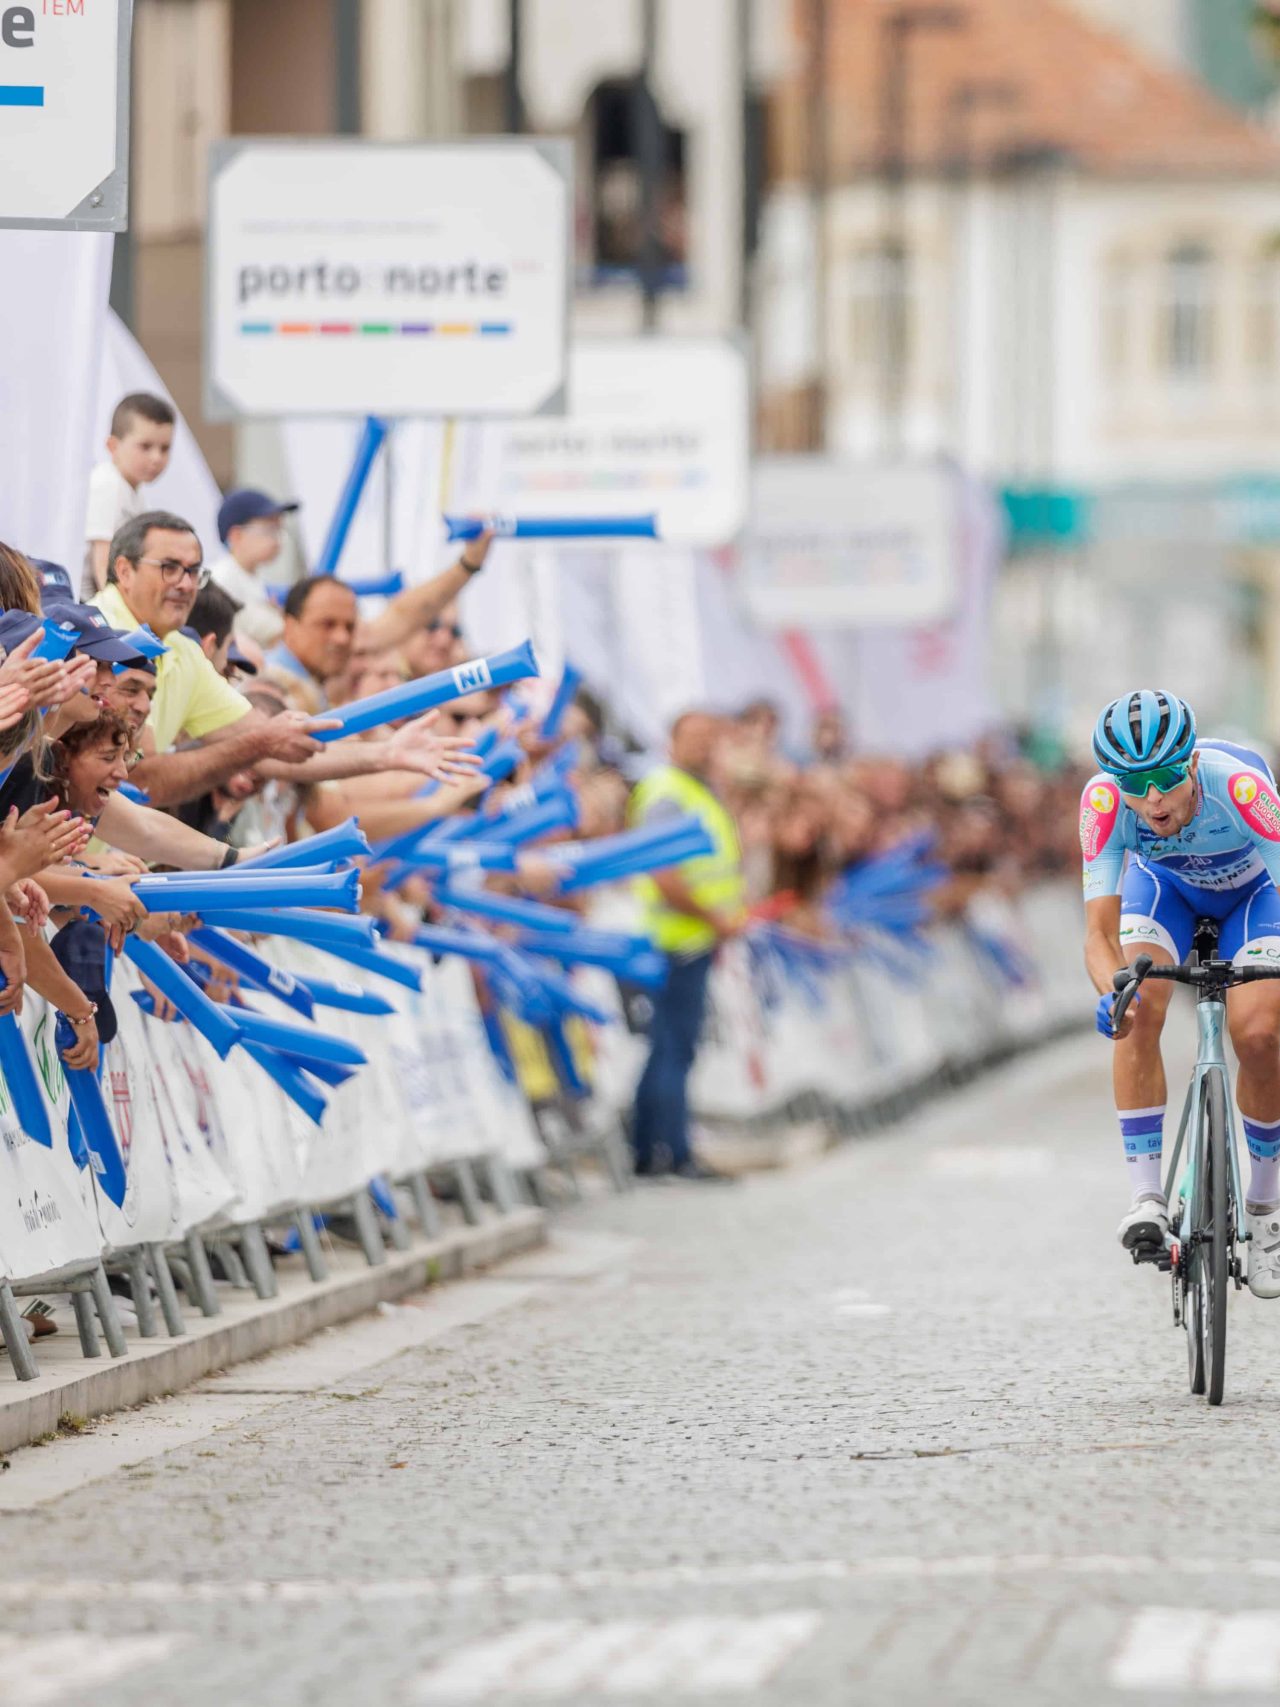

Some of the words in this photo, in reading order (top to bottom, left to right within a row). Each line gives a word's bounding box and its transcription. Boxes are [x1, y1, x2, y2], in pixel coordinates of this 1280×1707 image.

[237, 257, 361, 306] porto
[384, 257, 508, 298] norte
[1137, 926, 1159, 937] CA
